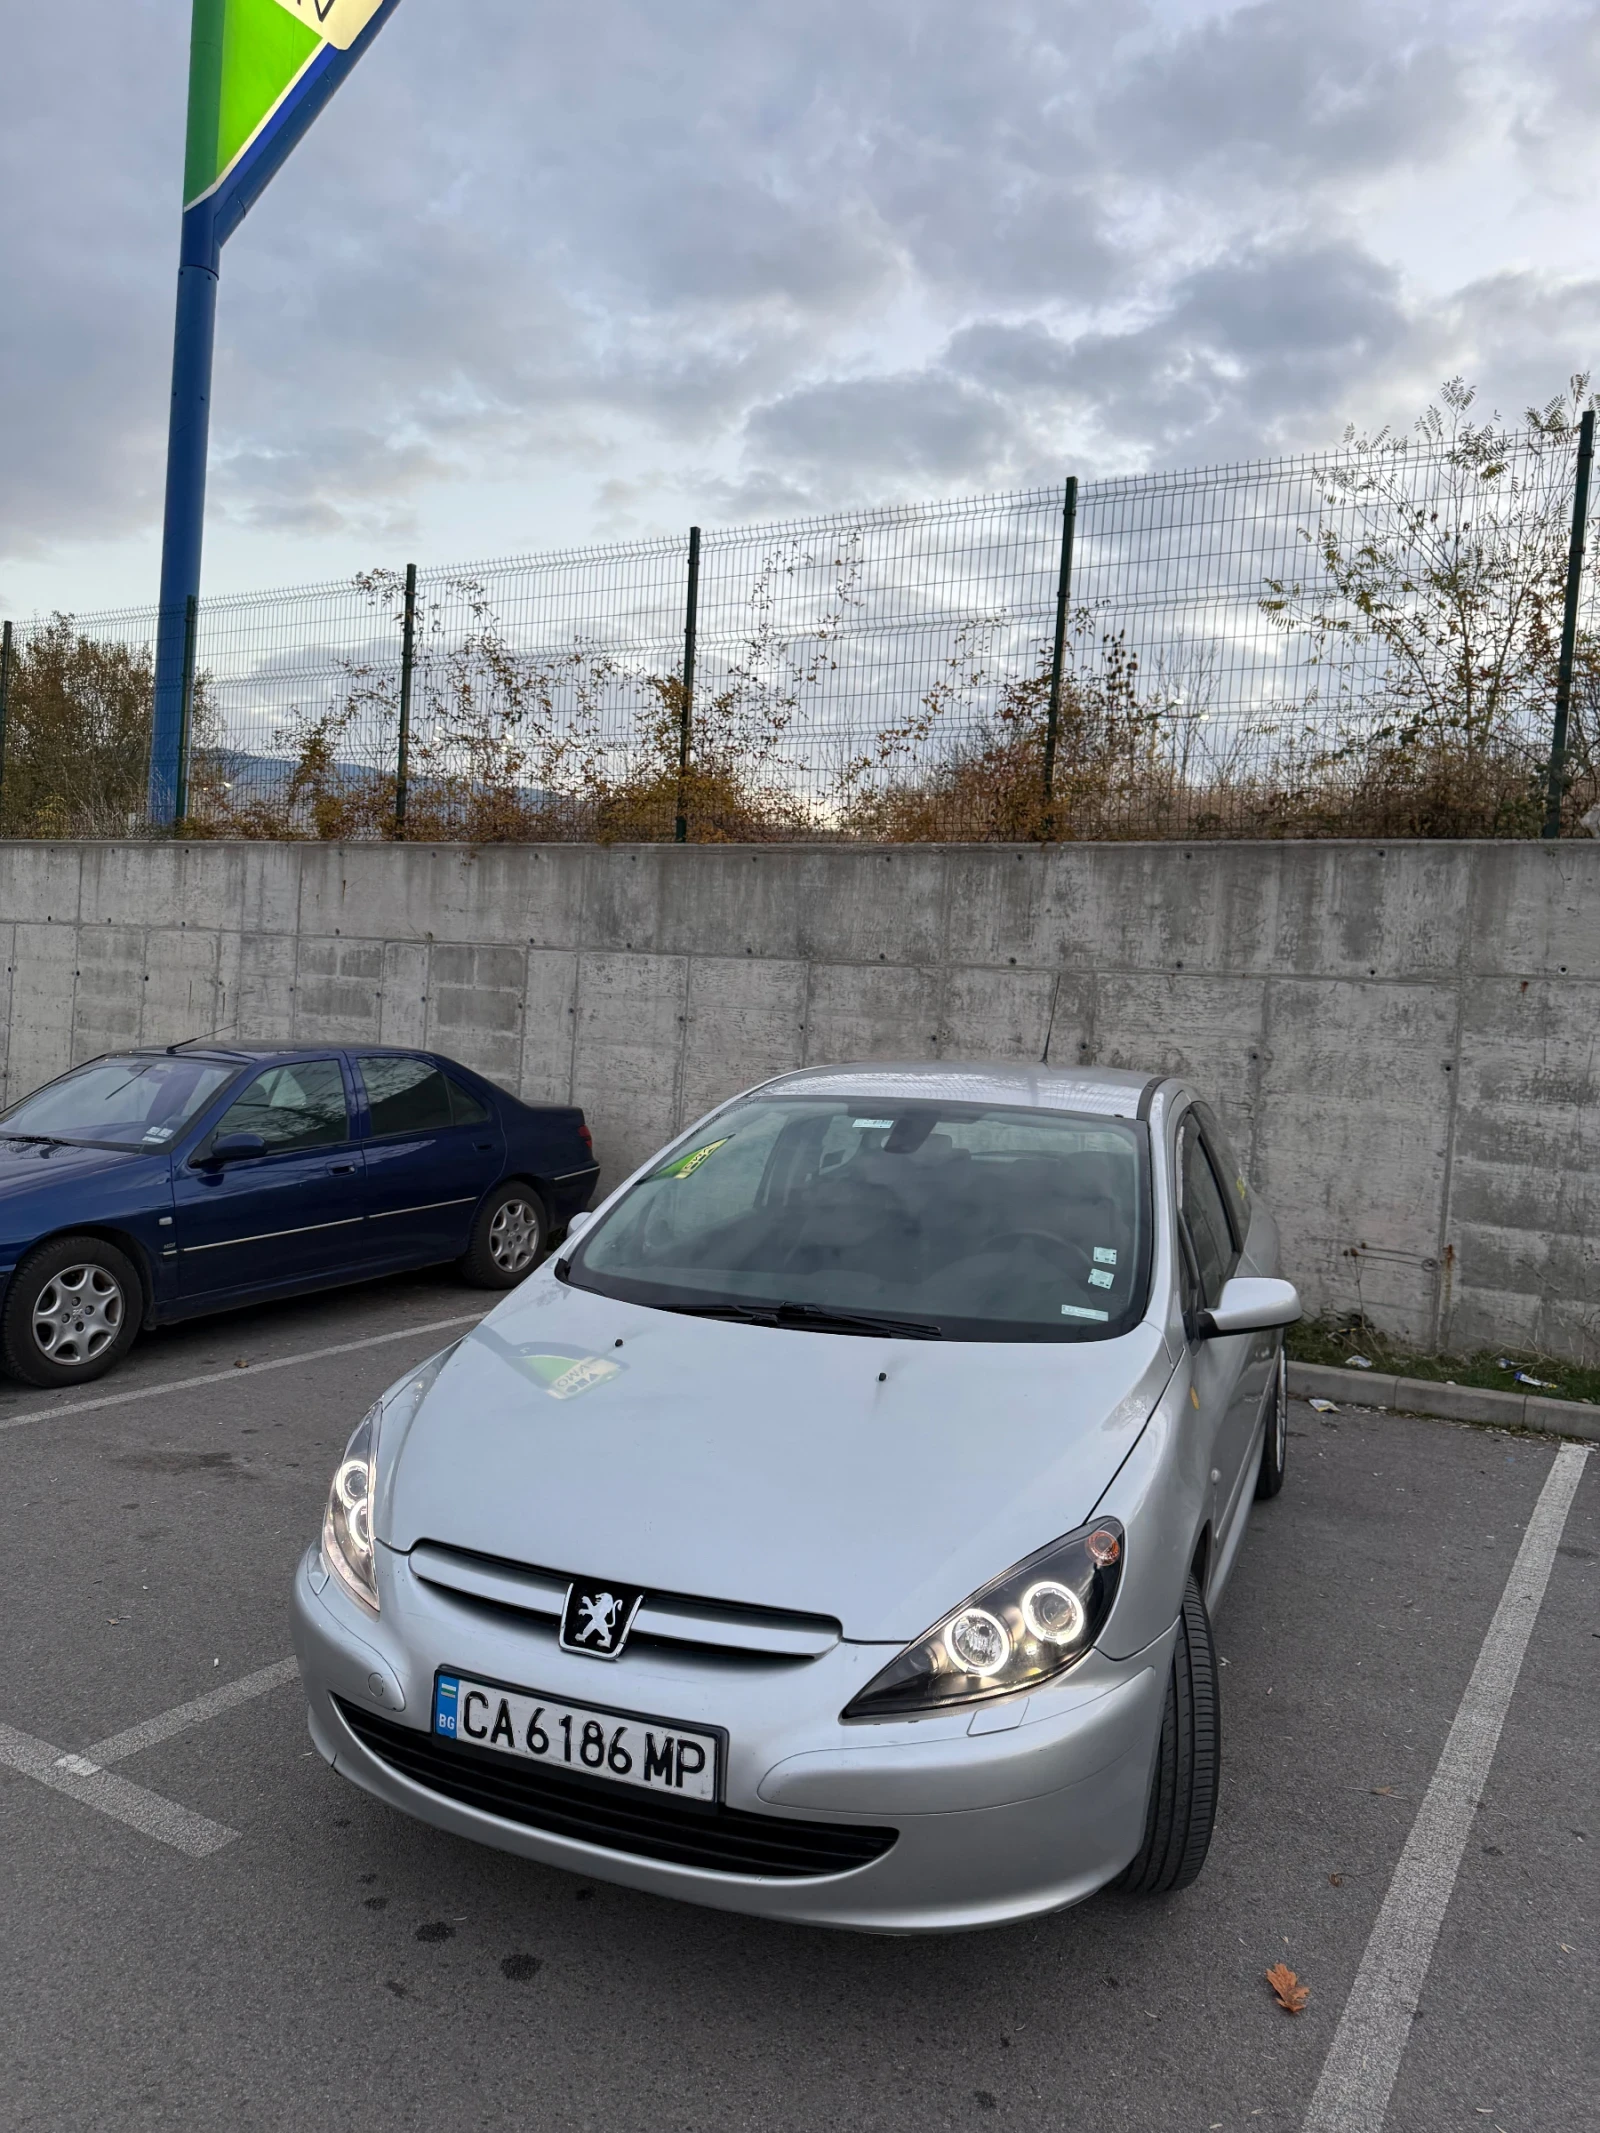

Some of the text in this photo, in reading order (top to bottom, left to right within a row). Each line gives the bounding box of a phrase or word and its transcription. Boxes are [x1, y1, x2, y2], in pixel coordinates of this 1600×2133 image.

[438, 1713, 455, 1731] BG
[463, 1690, 706, 1788] CA 6186 MP
